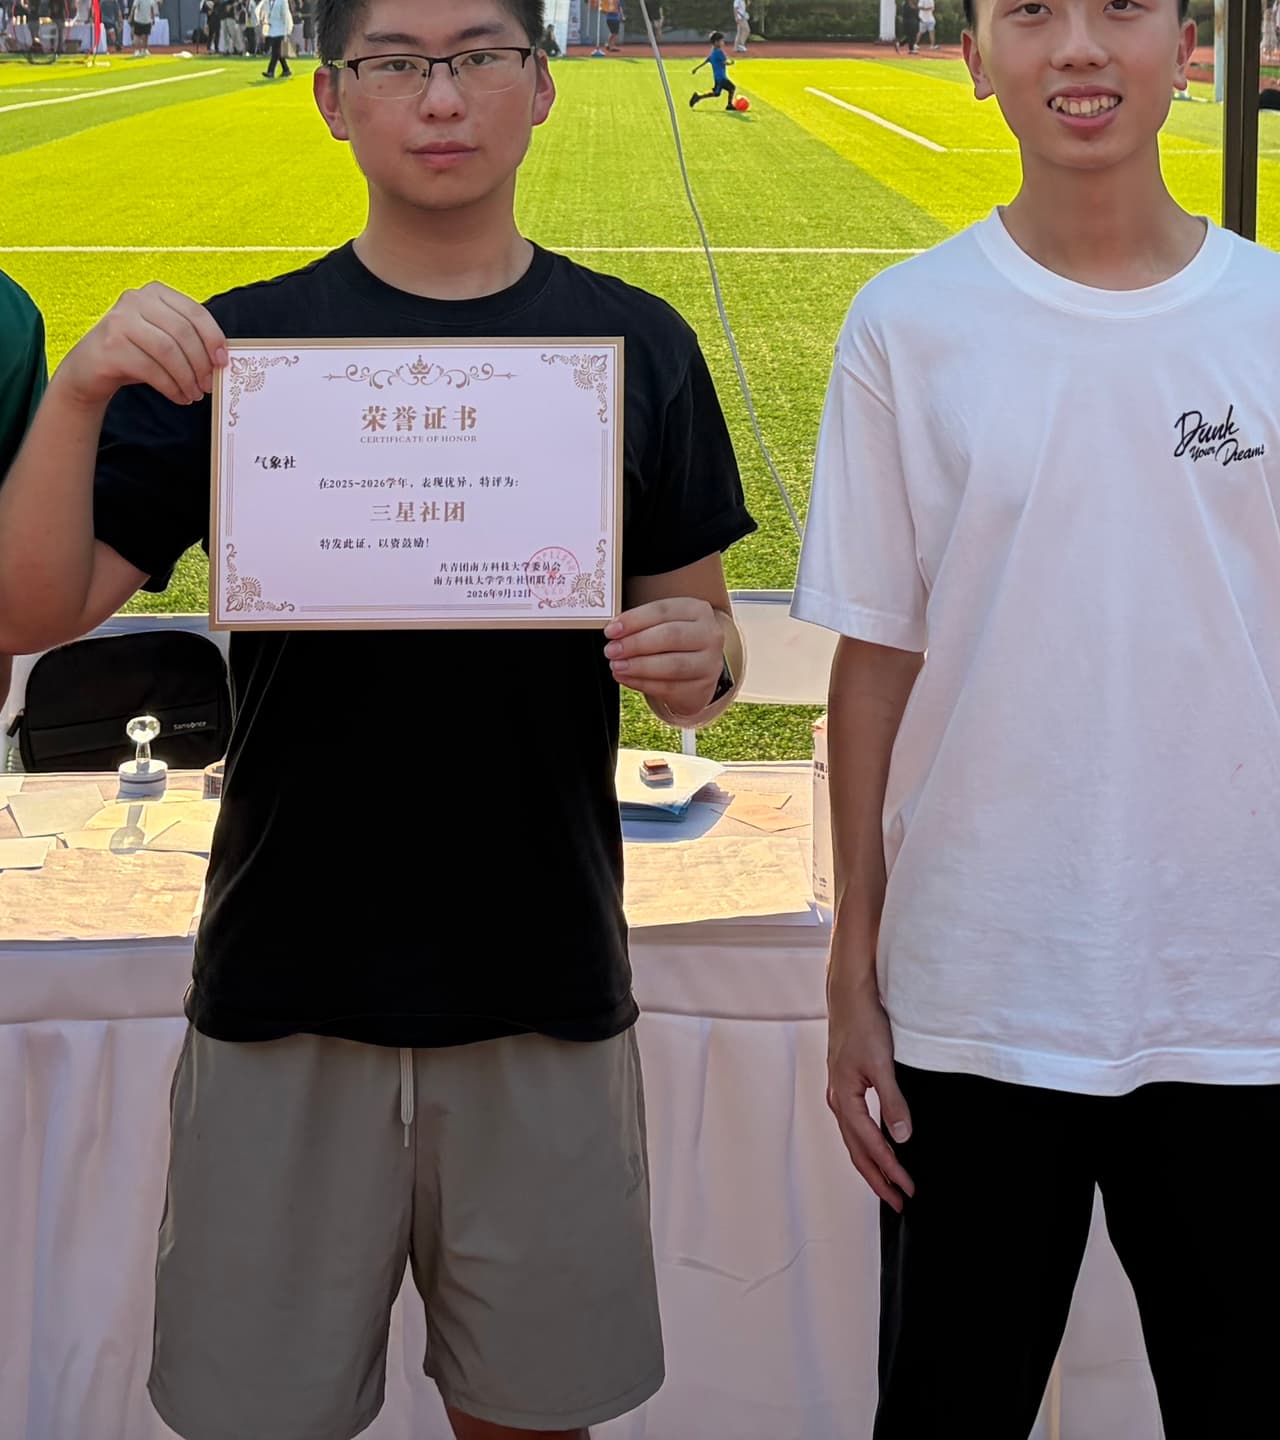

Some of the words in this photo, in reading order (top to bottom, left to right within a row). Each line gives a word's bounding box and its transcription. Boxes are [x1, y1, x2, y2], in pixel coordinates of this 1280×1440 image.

[361, 405, 477, 432] 荣誉证书
[360, 435, 422, 443] CERTIFICATE
[1174, 404, 1239, 457] Dunk
[255, 455, 296, 469] 气象社
[371, 501, 465, 522] 三星社团
[467, 588, 531, 598] 2026年9月12日
